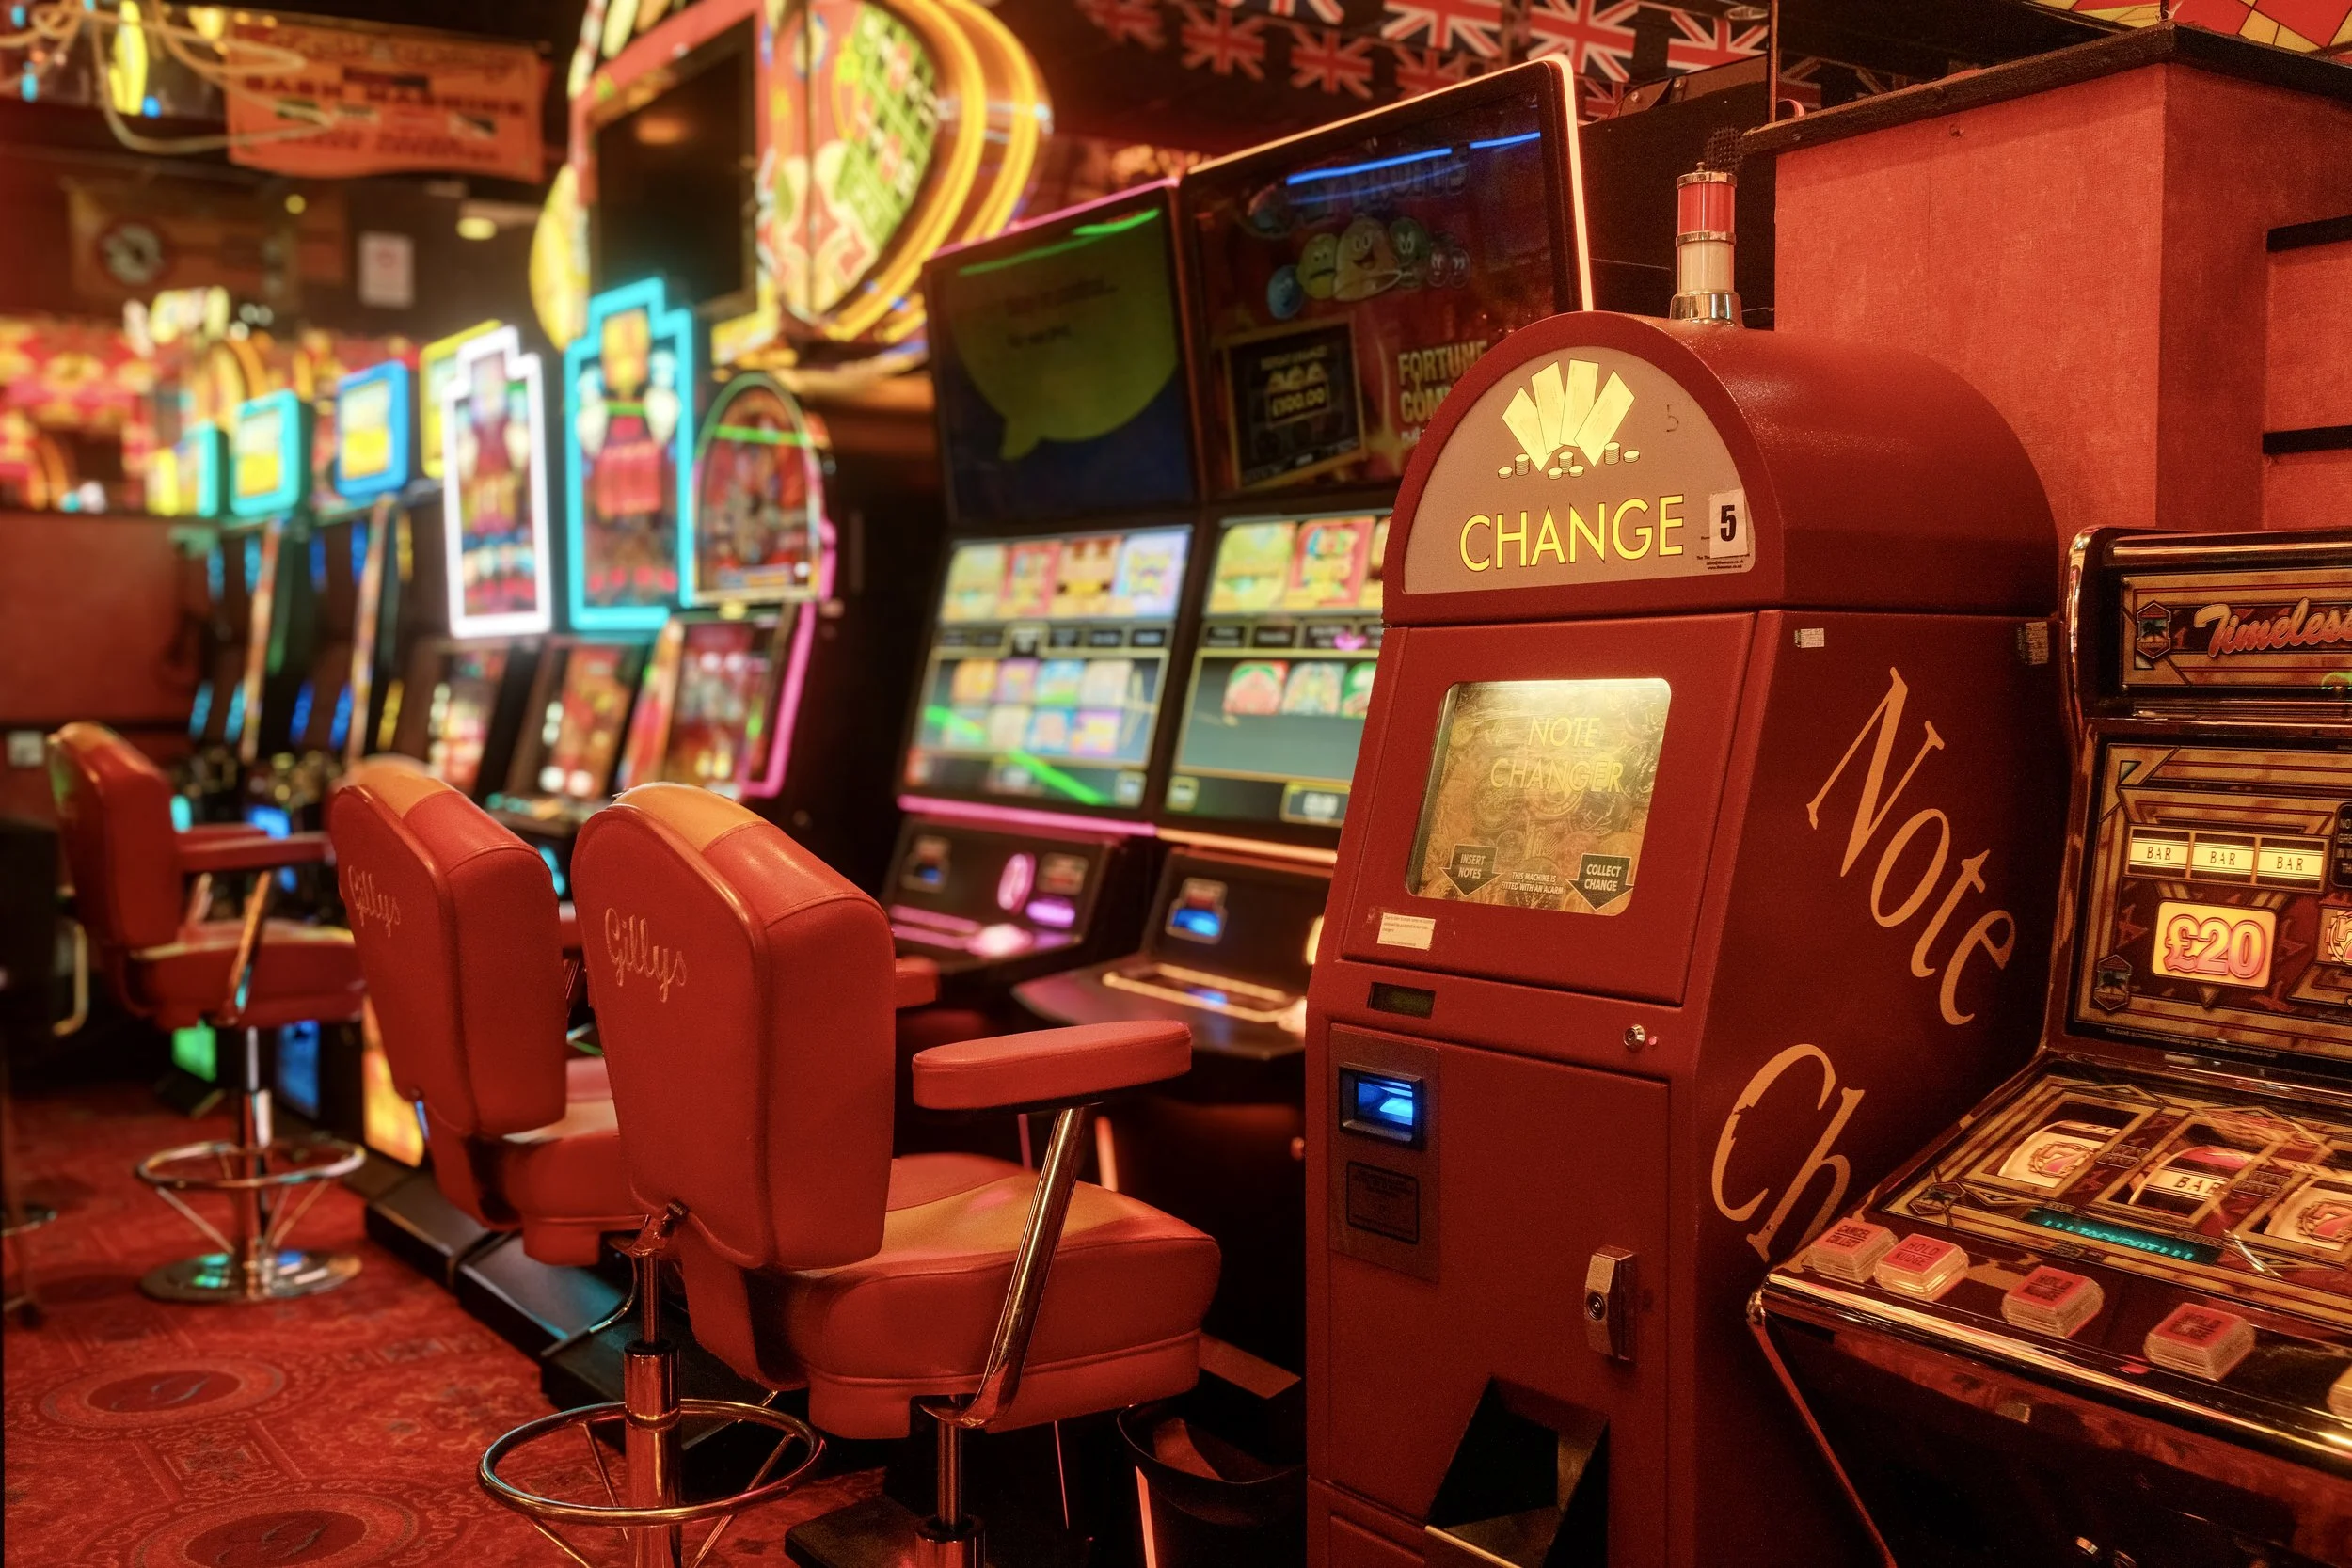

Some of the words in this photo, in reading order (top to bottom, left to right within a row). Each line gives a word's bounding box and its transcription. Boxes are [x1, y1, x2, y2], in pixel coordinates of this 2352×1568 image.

[1720, 504, 1737, 542] 5
[1459, 494, 1684, 572] CHANGE
[1527, 716, 1601, 747] NOTE
[1490, 758, 1625, 793] CHANGER
[1805, 666, 2016, 1026] Note
[1460, 853, 1486, 867] INSERT
[2146, 846, 2172, 862] BAR
[2209, 850, 2236, 866] BAR
[2277, 855, 2304, 872] BAR
[1458, 866, 1482, 879] NOTES
[1512, 871, 1524, 881] THIS
[1524, 871, 1549, 882] MACHINE
[1549, 873, 1557, 882] IS
[1586, 863, 1622, 878] COLLECT
[1501, 880, 1518, 891] FITTED
[1518, 881, 1534, 893] WITH
[1534, 883, 1543, 893] AN
[1543, 883, 1564, 895] ALARM
[1584, 879, 1618, 892] CHANGE
[347, 864, 401, 937] Gillys
[2164, 913, 2266, 979] £20
[604, 906, 688, 1003] Gillys
[1836, 1225, 1871, 1239] CANCEL
[1825, 1234, 1862, 1249] COLLECT
[1905, 1242, 1940, 1256] HOLD
[1893, 1253, 1930, 1266] NUDGE
[2035, 1274, 2073, 1291] HOLD
